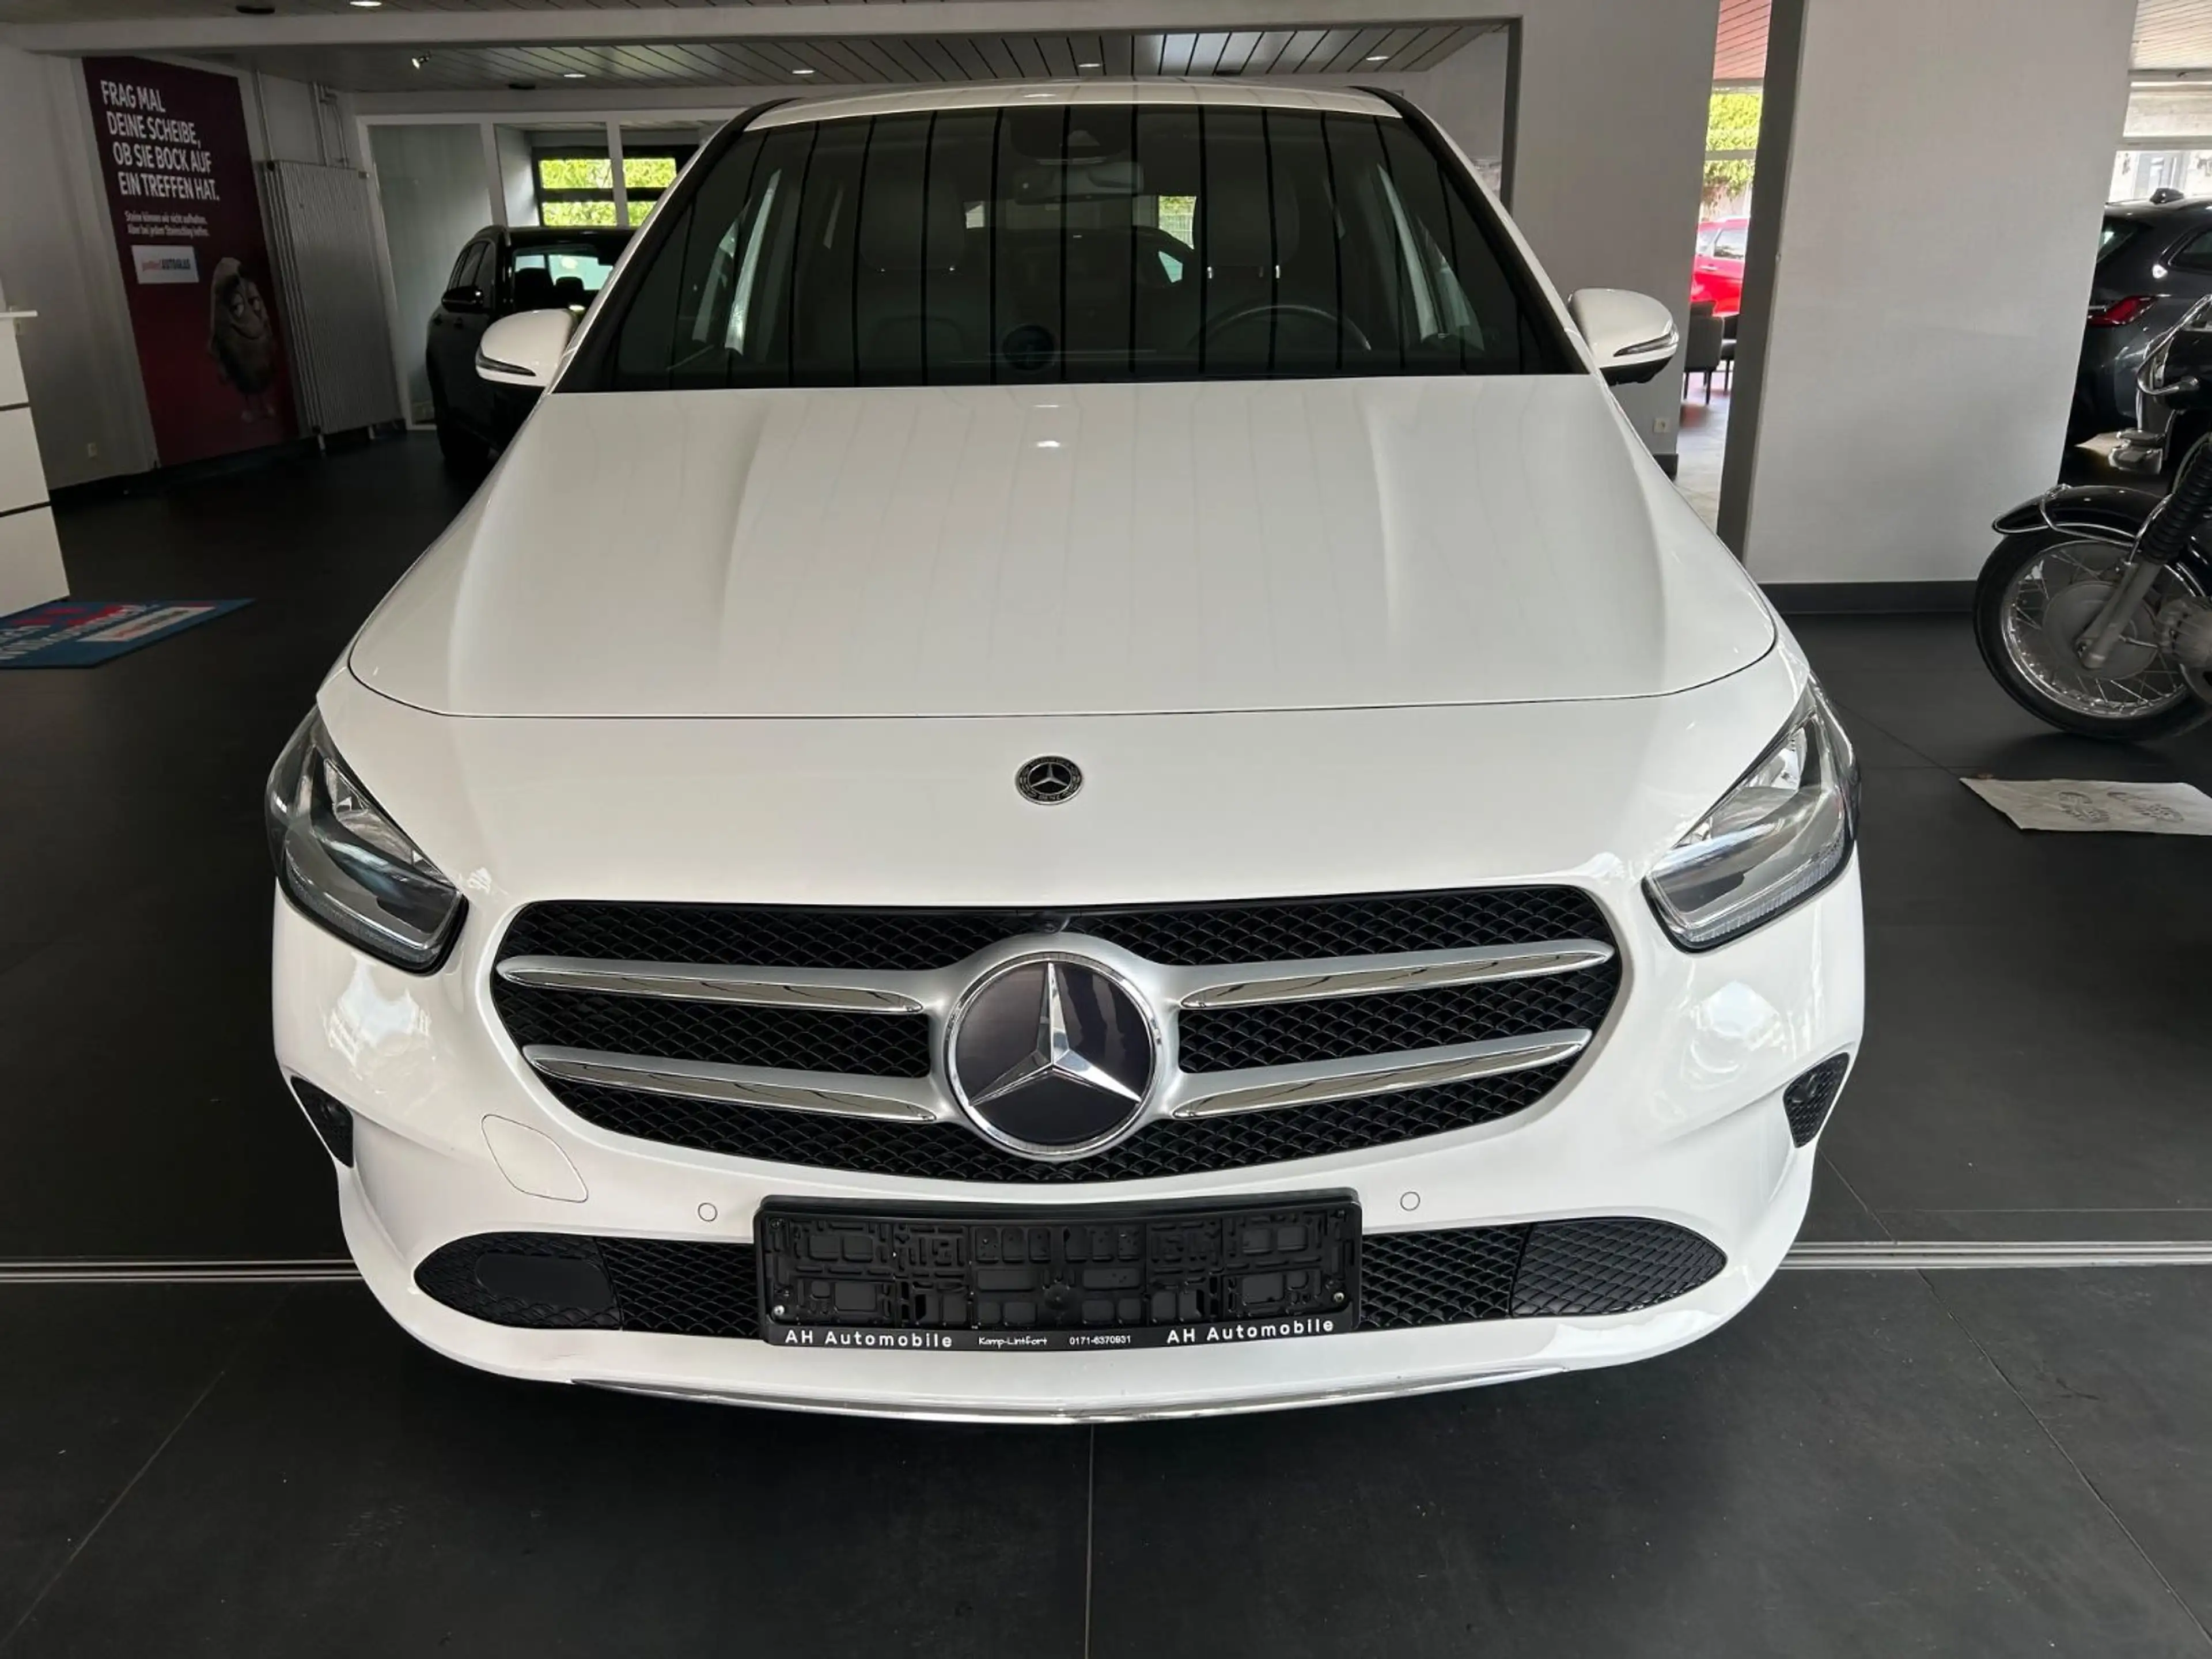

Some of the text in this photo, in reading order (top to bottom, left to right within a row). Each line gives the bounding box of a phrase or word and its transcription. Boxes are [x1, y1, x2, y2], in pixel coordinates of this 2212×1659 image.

[100, 79, 166, 113] FRAG MAL
[106, 111, 201, 149] DEINE SCHEIBE,
[113, 141, 213, 174] OB SIE BOCK AUF
[118, 171, 221, 201] EIN TREFFEN HAT.
[785, 1330, 813, 1343] AH
[825, 1331, 952, 1347] Automobile
[1167, 1328, 1195, 1343] AH
[1207, 1319, 1334, 1340] Automobile
